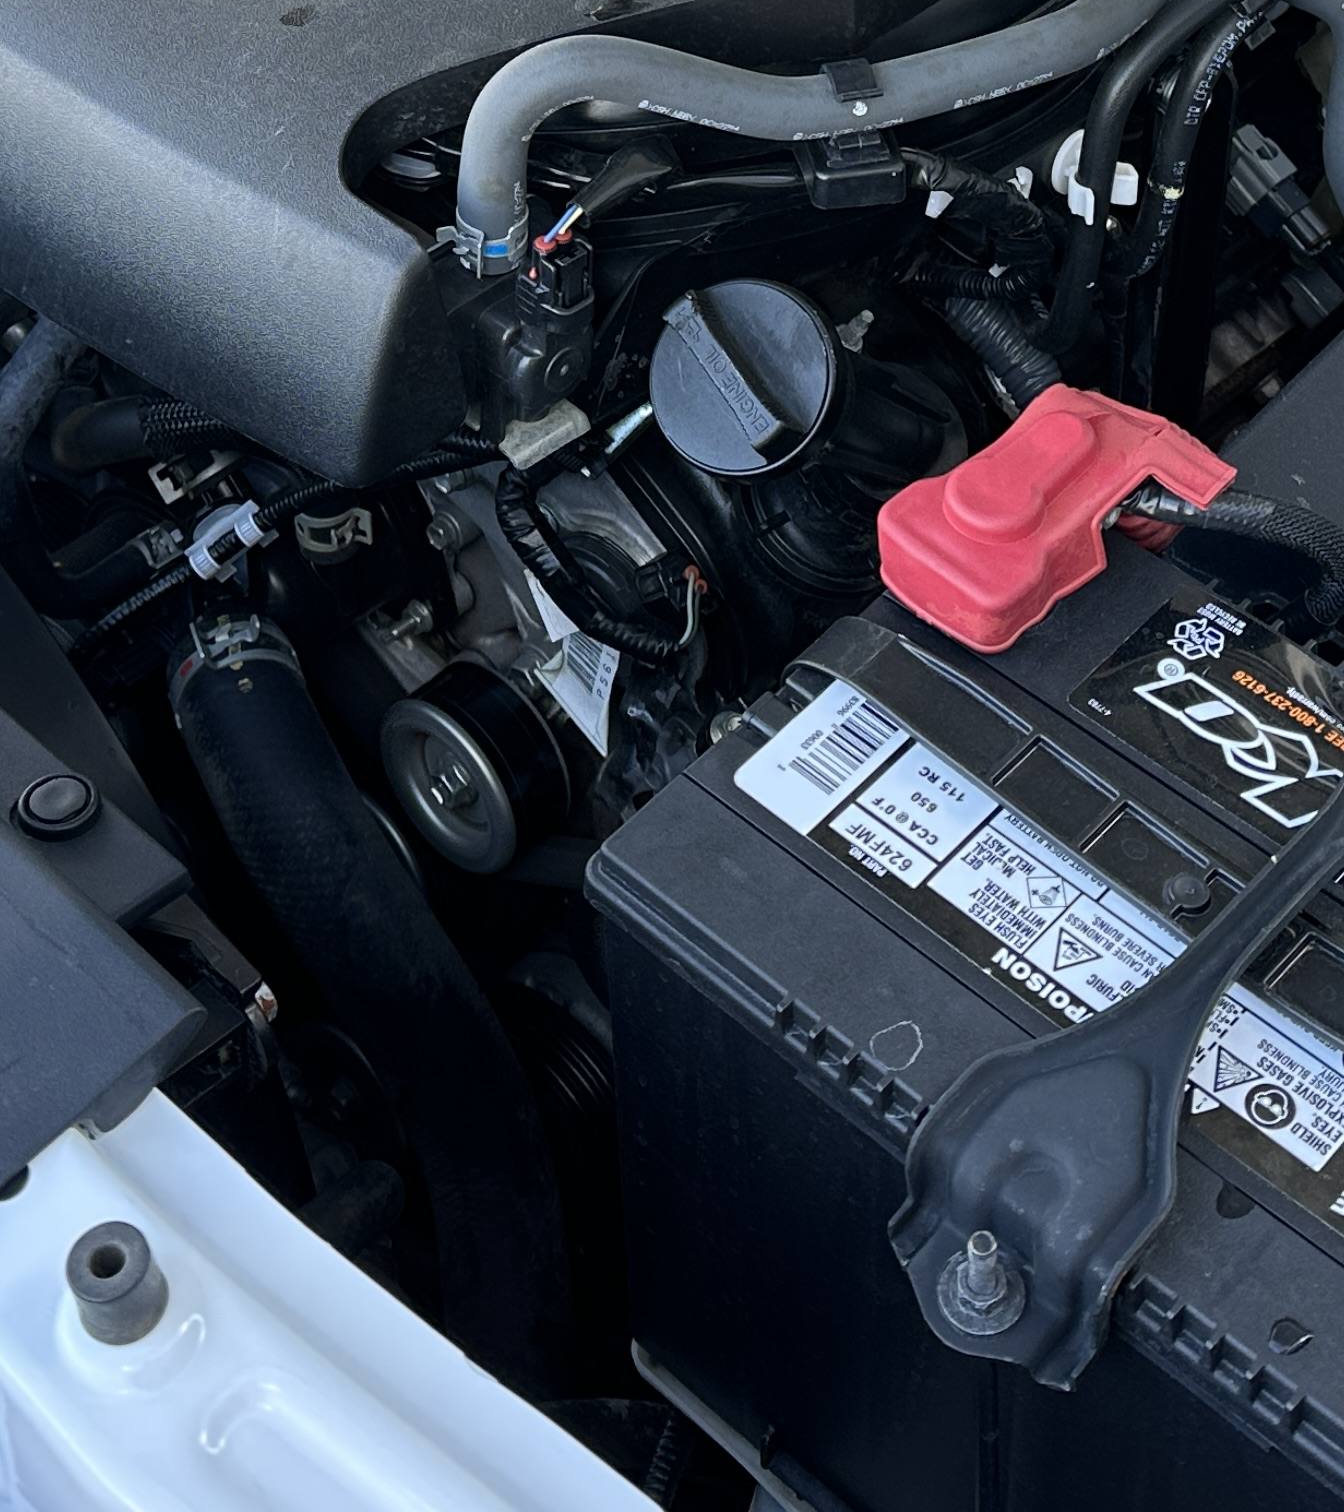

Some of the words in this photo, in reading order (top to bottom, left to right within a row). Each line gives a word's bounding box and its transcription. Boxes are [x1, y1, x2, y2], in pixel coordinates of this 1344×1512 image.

[702, 343, 728, 375] OIL
[719, 371, 770, 436] ENGINE
[1231, 668, 1326, 734] 1-800-237-6126
[917, 765, 940, 783] RC
[910, 790, 938, 814] 650
[939, 779, 967, 803] 115
[844, 819, 913, 872] 624FMF
[908, 820, 939, 846] CCA
[982, 832, 1010, 856] FAST.
[847, 844, 865, 860] NO.
[960, 850, 984, 870] GET
[1007, 852, 1035, 874] HELP
[861, 855, 887, 877] PART
[981, 877, 1021, 910] WATER.
[967, 902, 996, 925] EYES
[968, 887, 1037, 939] IMMEDIATELY
[1017, 904, 1046, 929] WITH
[993, 921, 1028, 948] FLUSH
[1064, 912, 1114, 952] BLINDNESS
[1113, 947, 1144, 972] CAUSE
[1123, 937, 1157, 966] SEVERE
[1256, 1038, 1311, 1079] BLINDNESS
[1256, 1055, 1294, 1085] GASES
[1309, 1075, 1342, 1101] CAUSE
[1289, 1121, 1331, 1155] SHIELD
[1309, 1112, 1343, 1142] EYES.
